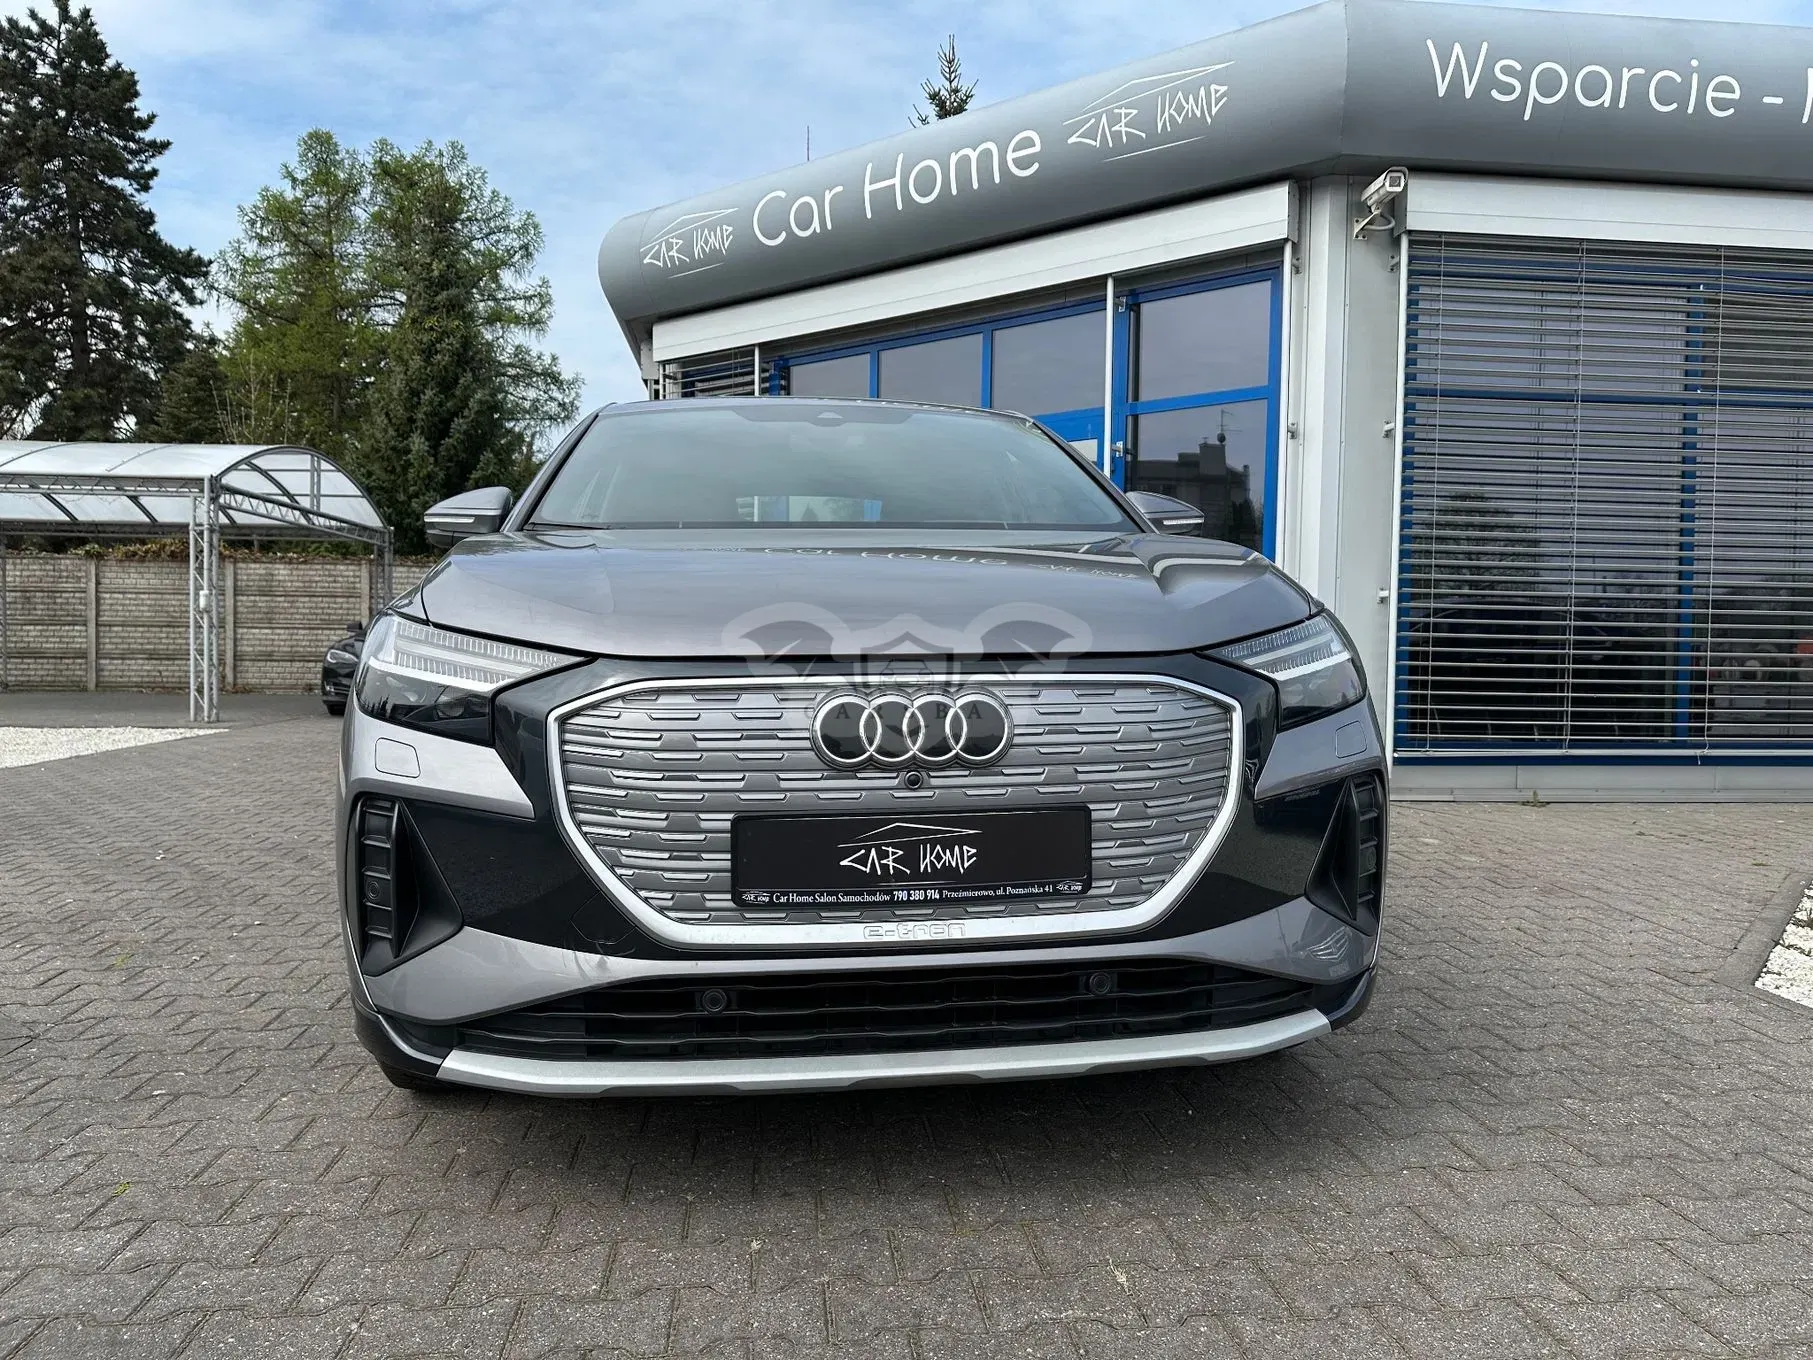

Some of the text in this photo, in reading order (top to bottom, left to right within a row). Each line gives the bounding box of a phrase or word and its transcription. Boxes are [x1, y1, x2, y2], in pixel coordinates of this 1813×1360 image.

[1425, 38, 1742, 121] Wsparcie
[1067, 83, 1229, 148] CAR HOME
[752, 129, 1042, 247] Car Home
[643, 224, 734, 268] CAR HOME
[839, 843, 977, 876] CAR HOME
[772, 892, 788, 903] Car
[789, 892, 814, 903] Home
[814, 891, 837, 903] Salon
[837, 891, 891, 903] Samochodów
[893, 890, 907, 901] 790
[909, 889, 924, 900] 380
[926, 889, 940, 900] 914
[996, 886, 1005, 895] ul.
[1006, 885, 1043, 895] Poznańska
[1044, 884, 1053, 893] 41
[863, 922, 966, 940] e-tron
